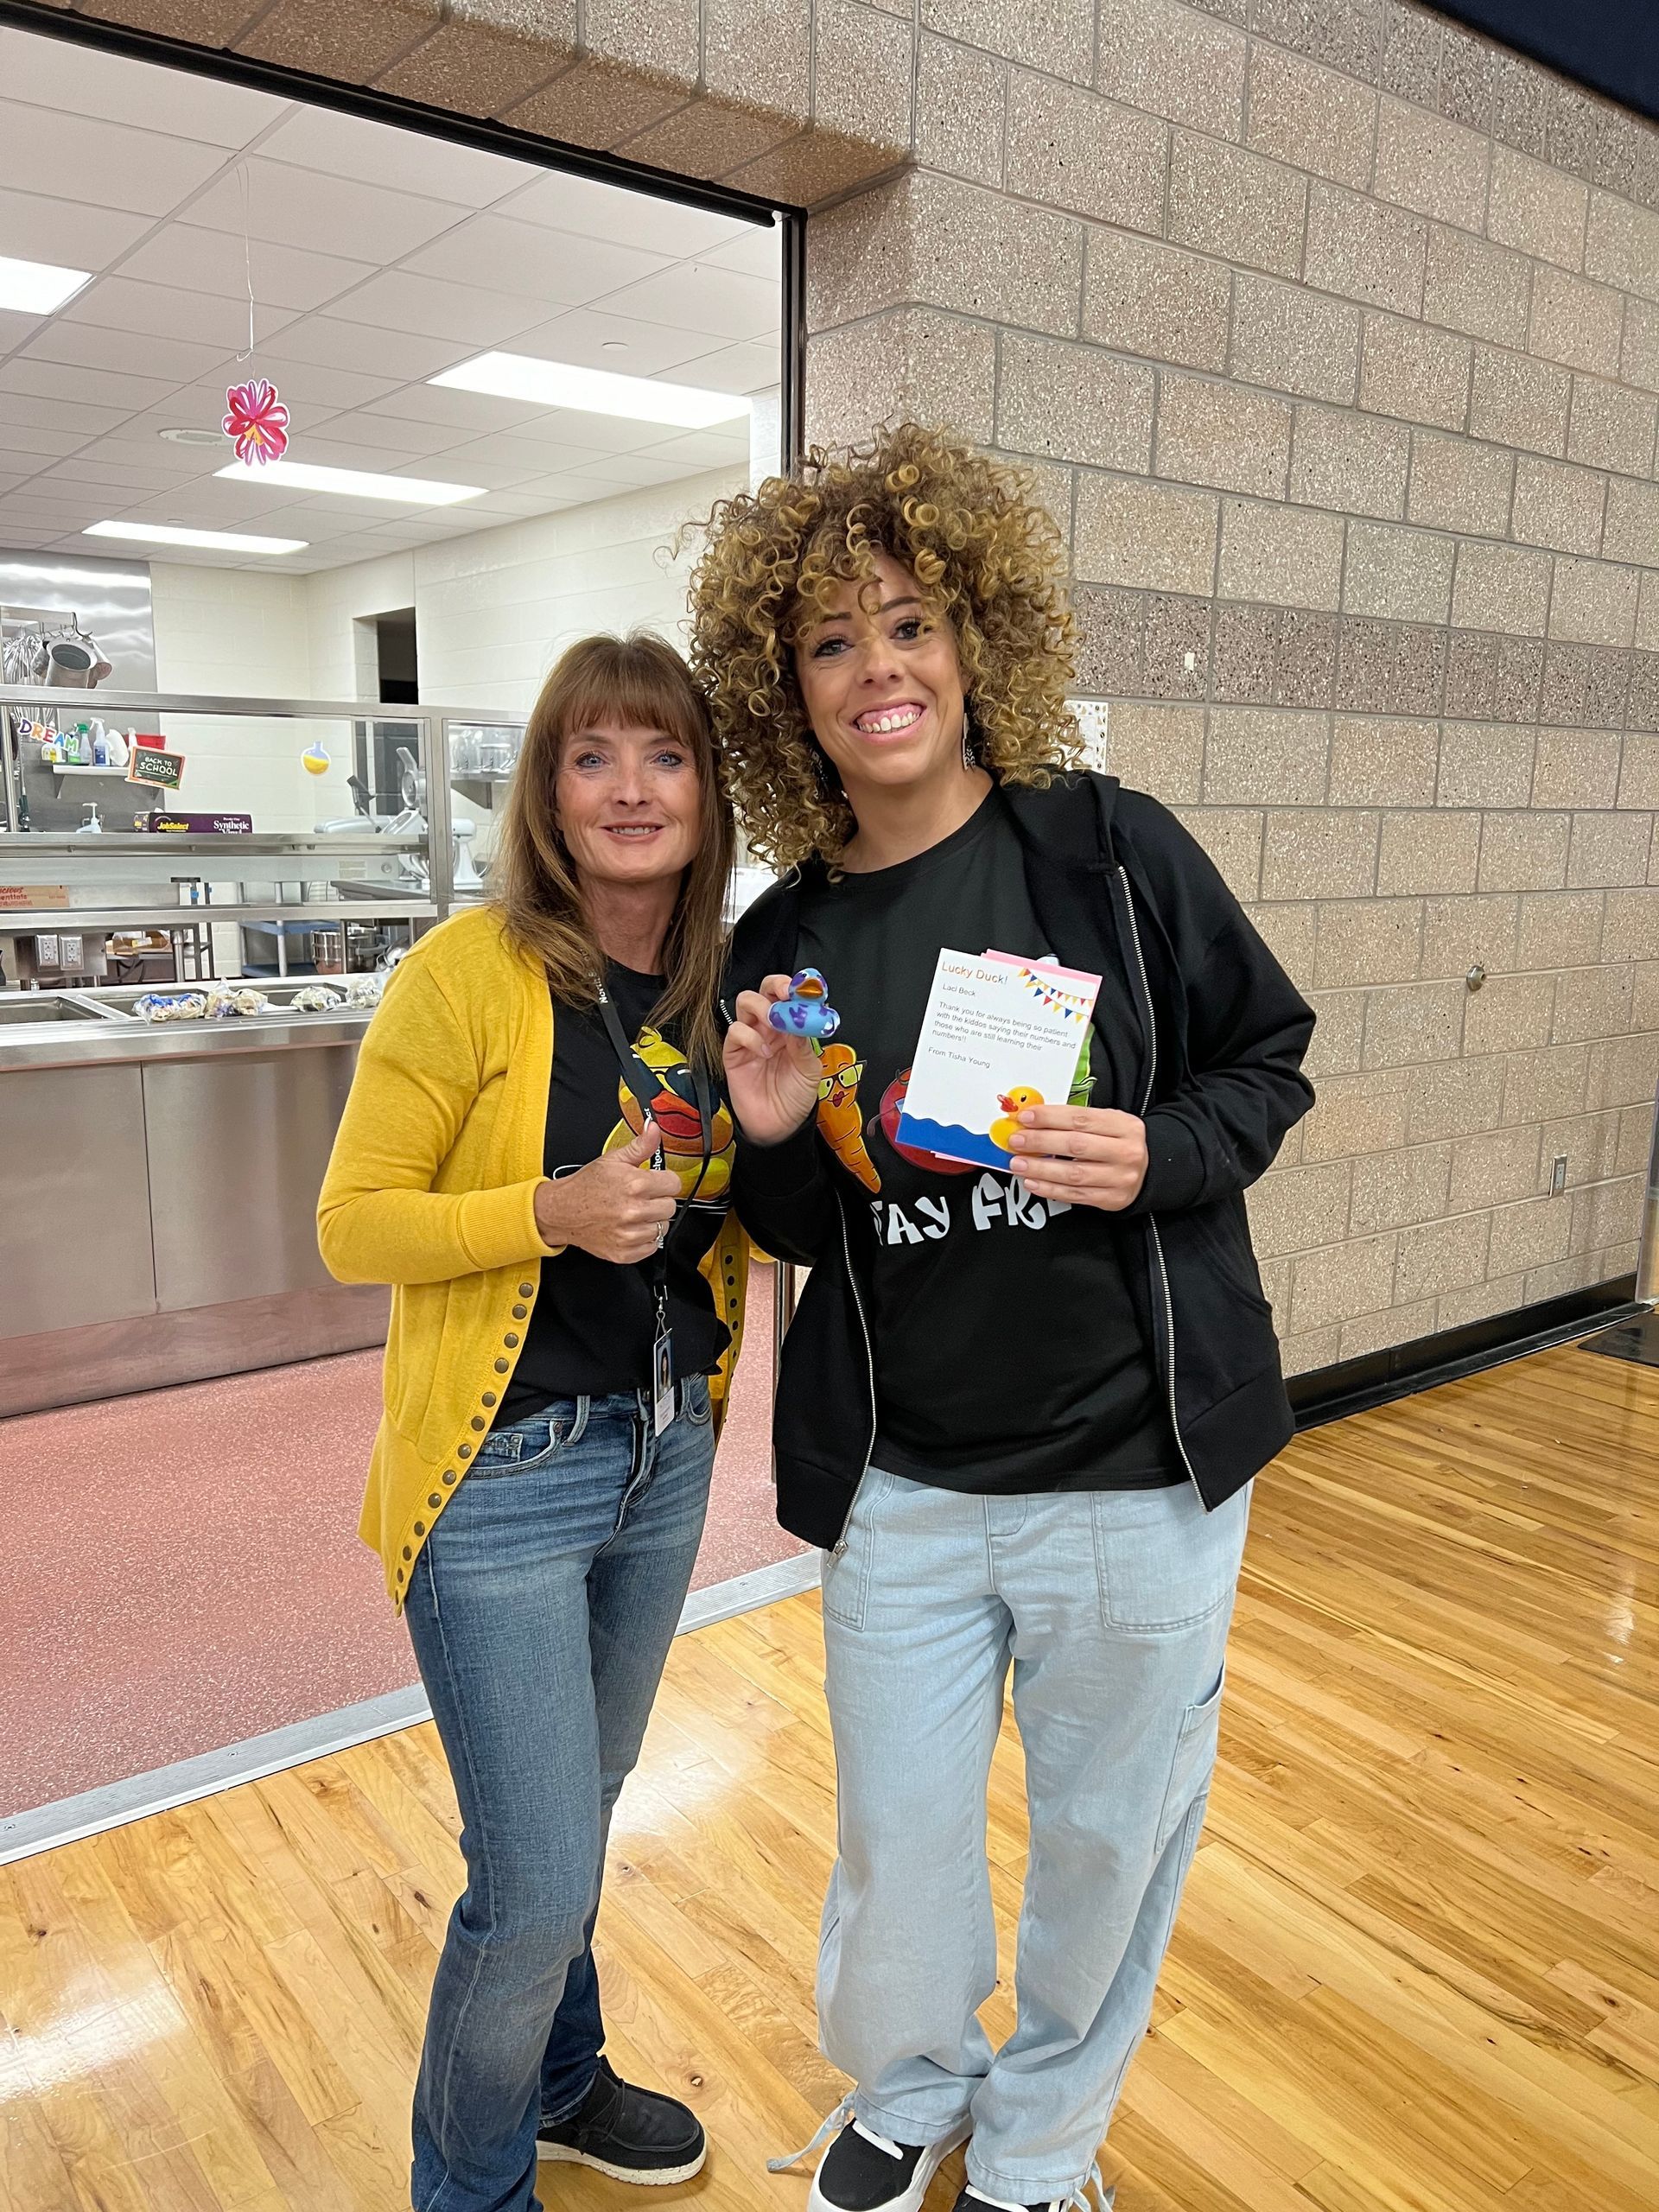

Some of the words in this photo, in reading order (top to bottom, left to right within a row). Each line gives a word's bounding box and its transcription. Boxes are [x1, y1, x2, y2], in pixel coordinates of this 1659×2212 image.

[20, 719, 79, 753] DREAM
[140, 762, 178, 776] SCHOOL
[144, 756, 163, 765] BACK
[213, 820, 249, 830] Synthetic
[942, 961, 973, 978] Lucky
[976, 969, 1008, 984] Duck!
[943, 983, 957, 992] Laci
[958, 987, 976, 996] Beck
[940, 1001, 959, 1012] Thank
[987, 1014, 1010, 1025] always
[1013, 1020, 1032, 1030] being
[1043, 1027, 1068, 1037] patient
[932, 1029, 967, 1043] numbers!!
[934, 1020, 953, 1030] those
[996, 1035, 1025, 1048] learning
[1027, 1042, 1042, 1051] their
[964, 1017, 987, 1028] kiddos
[988, 1024, 1011, 1035] saying
[1013, 1029, 1028, 1038] their
[1030, 1033, 1060, 1046] numbers
[928, 1047, 946, 1056] From
[949, 1051, 966, 1062] Tisha
[969, 1057, 990, 1069] Young
